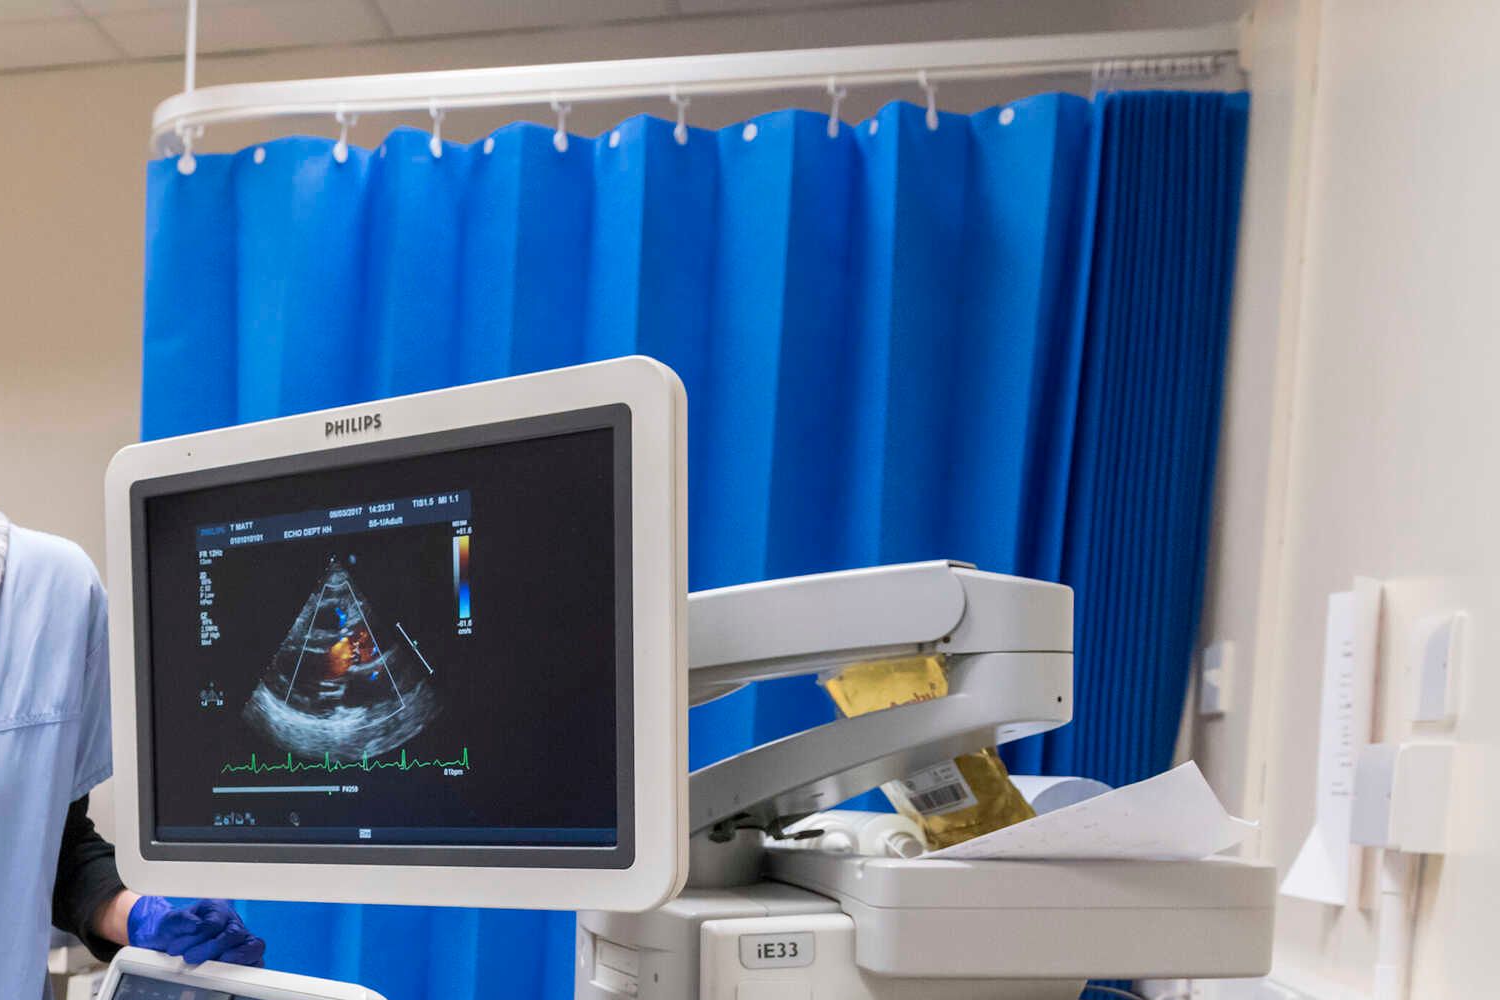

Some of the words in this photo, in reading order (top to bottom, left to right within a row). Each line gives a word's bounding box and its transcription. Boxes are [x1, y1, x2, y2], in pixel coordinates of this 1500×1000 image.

[325, 413, 382, 437] PHILIPS
[235, 521, 253, 531] MATT
[283, 529, 302, 539] ECHO
[303, 526, 320, 536] DEPT
[757, 942, 799, 959] iE33
